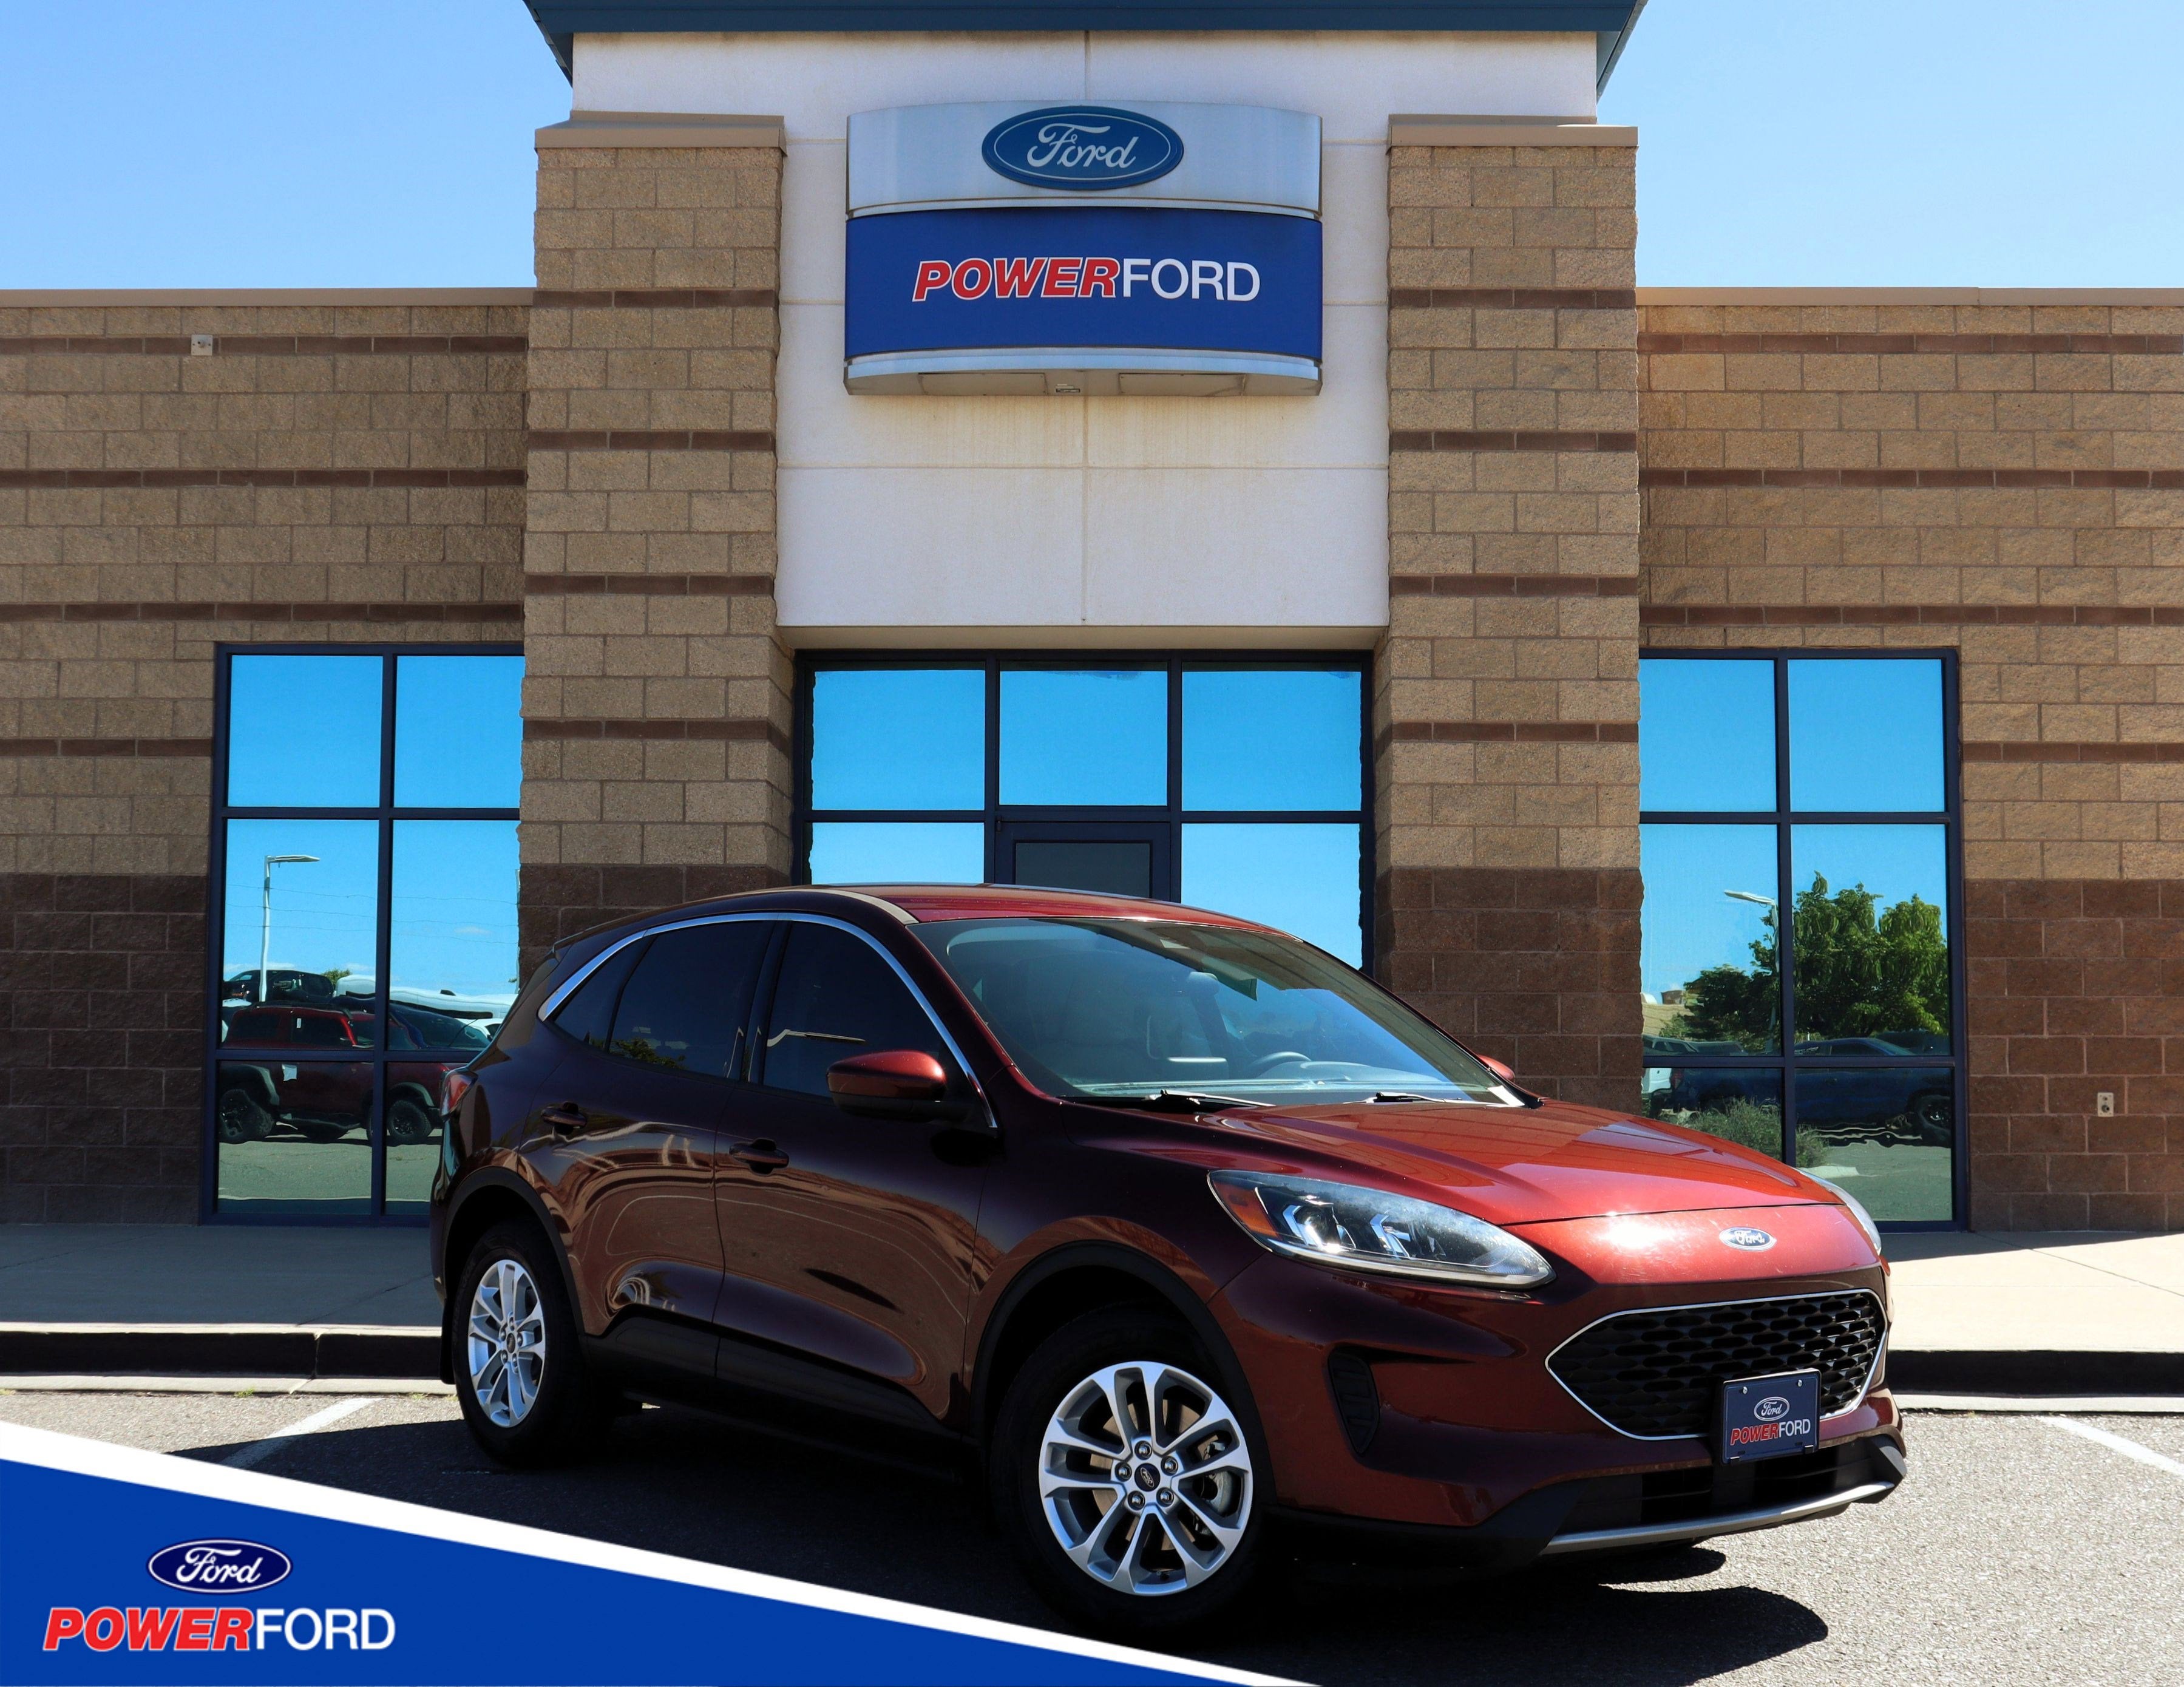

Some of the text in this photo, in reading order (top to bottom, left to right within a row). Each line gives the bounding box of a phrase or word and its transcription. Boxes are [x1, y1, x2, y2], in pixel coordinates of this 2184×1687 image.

[1027, 123, 1139, 168] Ford
[1734, 1230, 1765, 1245] Ford
[1761, 1402, 1782, 1416] Ford
